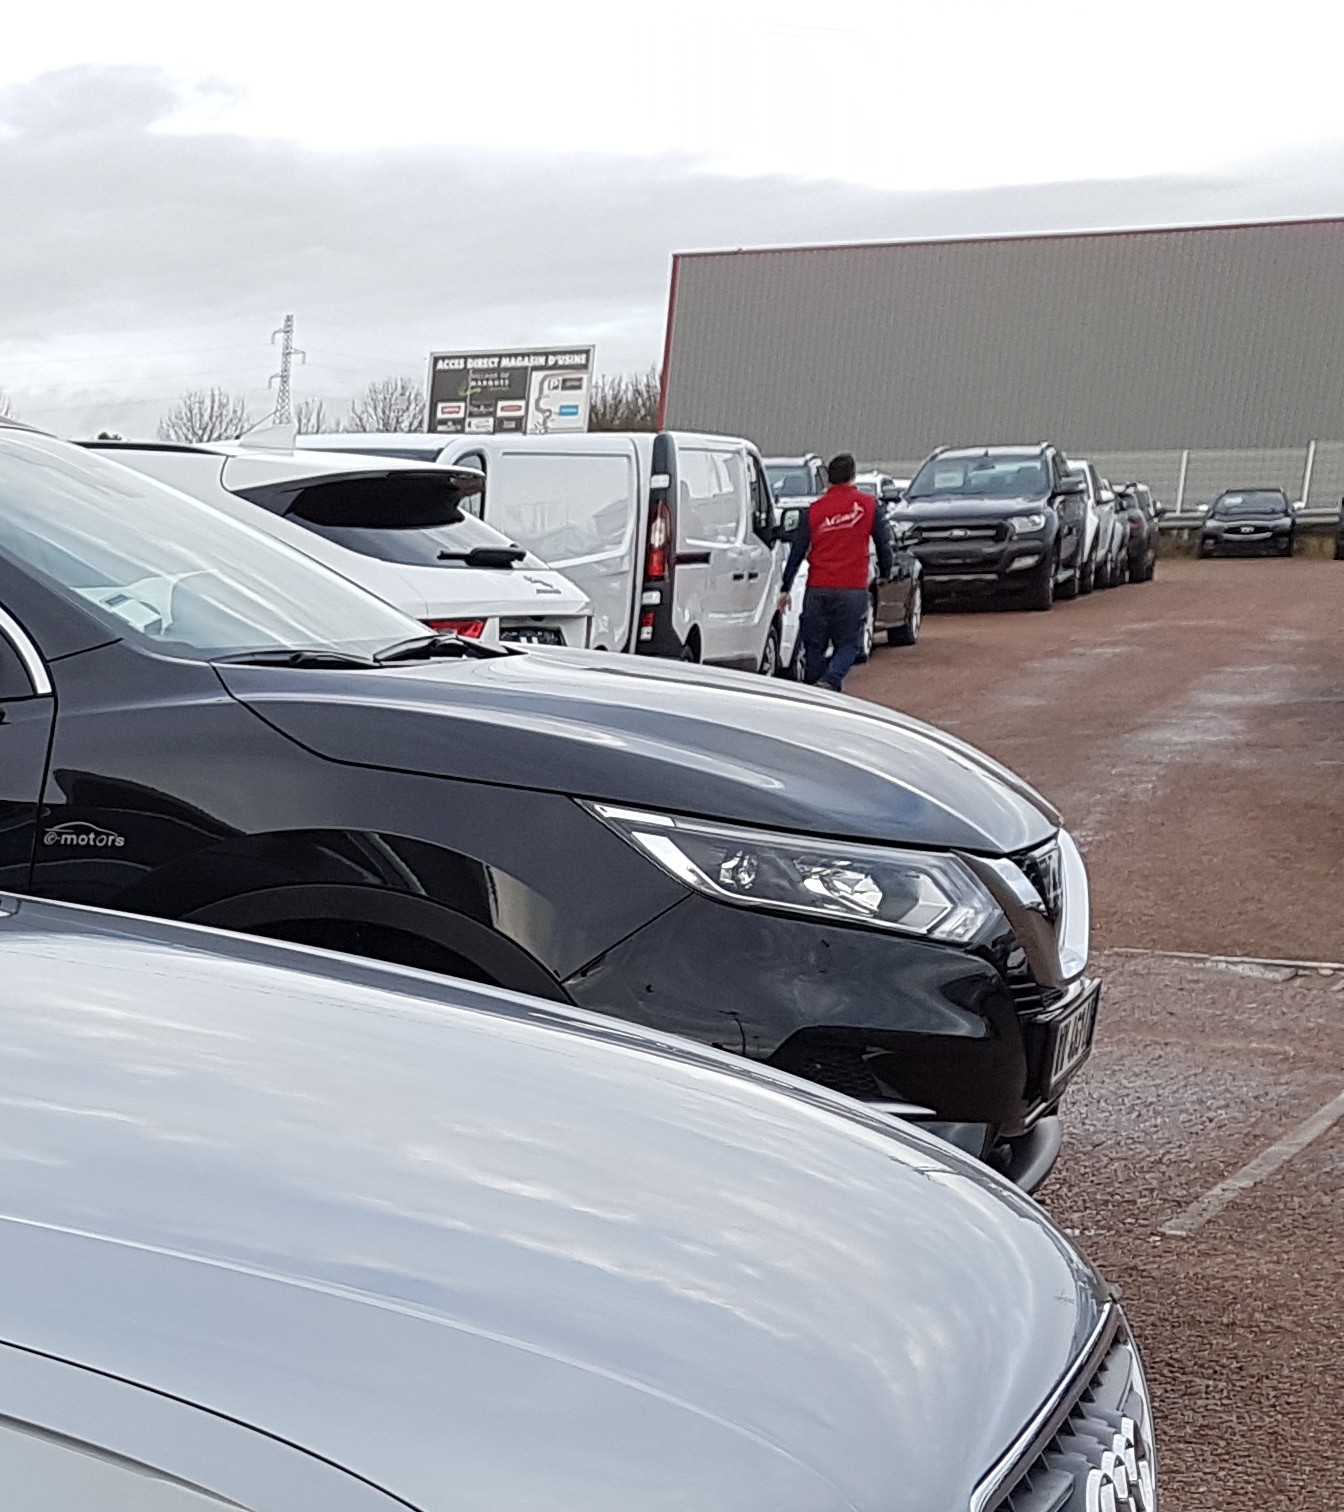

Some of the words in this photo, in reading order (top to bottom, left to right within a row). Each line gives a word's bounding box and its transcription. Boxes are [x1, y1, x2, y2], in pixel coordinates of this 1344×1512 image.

[436, 358, 465, 370] ACCES
[467, 356, 499, 369] DIRECT
[500, 355, 546, 368] MAGASIN
